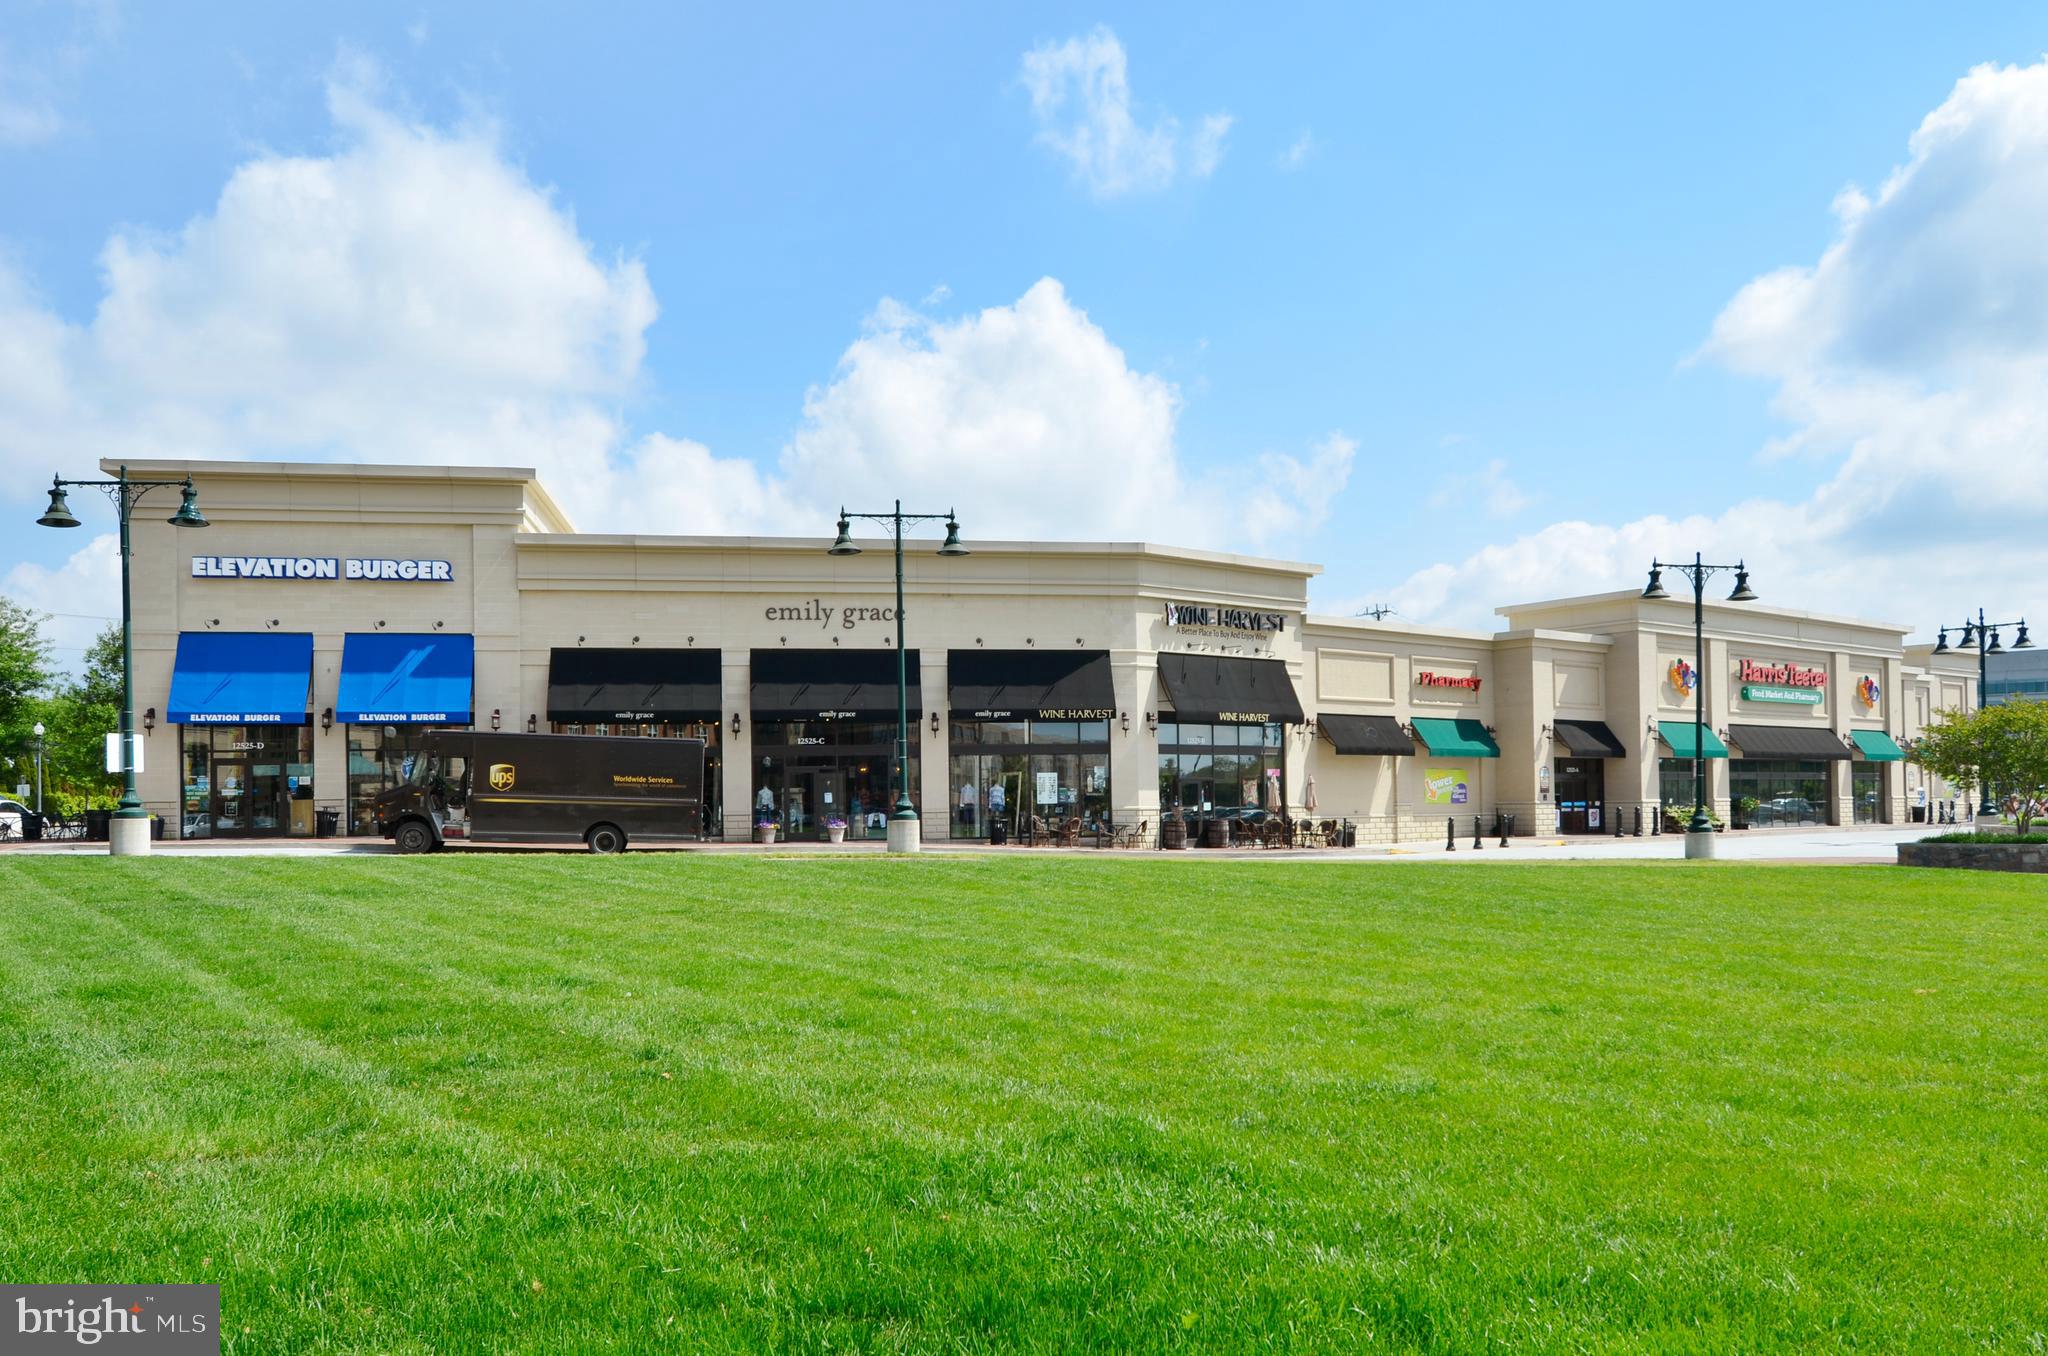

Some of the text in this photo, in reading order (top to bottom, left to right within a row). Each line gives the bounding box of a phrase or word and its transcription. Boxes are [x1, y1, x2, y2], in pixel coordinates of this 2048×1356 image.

[192, 556, 454, 582] ELEVATION BURGER
[765, 599, 834, 629] emily
[1175, 605, 1288, 632] WINE HARVEST
[1181, 627, 1198, 636] Better
[1198, 628, 1213, 637] Place
[1213, 629, 1219, 637] To
[1220, 630, 1229, 640] Buy
[1230, 631, 1240, 639] And
[1241, 632, 1254, 642] Enjoy
[1255, 633, 1267, 641] Wine
[1739, 658, 1828, 687] Harris Teeter
[1418, 671, 1482, 692] Pharmacy
[1751, 689, 1819, 703] Food Market And Pharmacy
[190, 714, 281, 722] ELEVATION BURGER
[358, 713, 446, 721] ELEVATION BURGER
[615, 711, 654, 720] emily grace
[819, 710, 856, 719] emily grace
[975, 710, 993, 719] emily
[1039, 709, 1113, 719] WINE HARVEST
[1219, 712, 1270, 722] WINE HARVEST
[232, 742, 265, 750] 12525-D
[797, 737, 826, 745] 12525-C
[491, 771, 513, 787] ups
[613, 775, 673, 784] Worldwide Services
